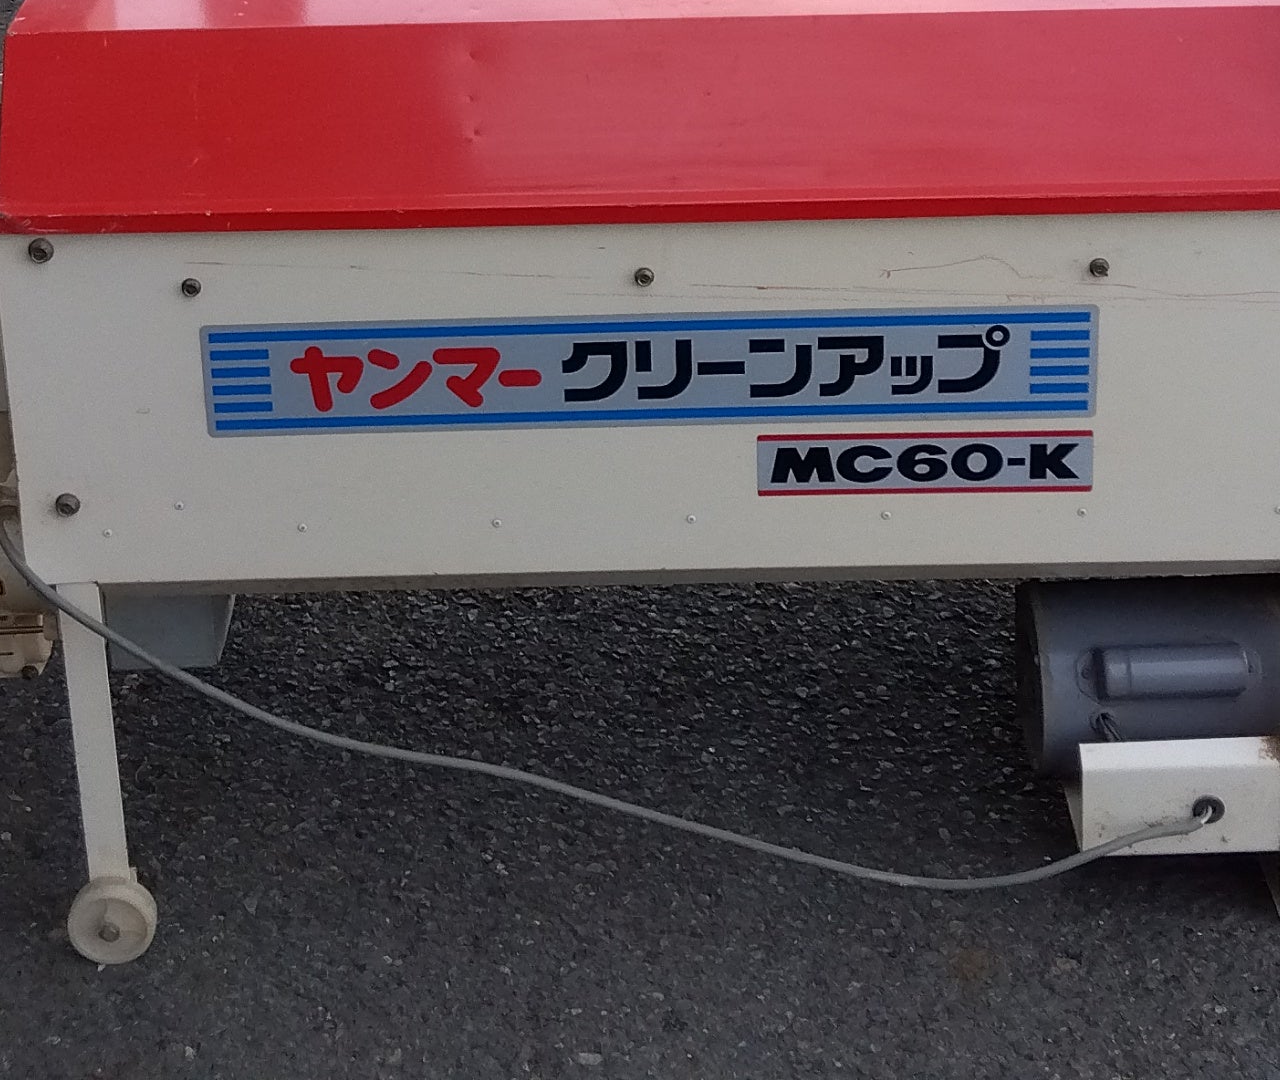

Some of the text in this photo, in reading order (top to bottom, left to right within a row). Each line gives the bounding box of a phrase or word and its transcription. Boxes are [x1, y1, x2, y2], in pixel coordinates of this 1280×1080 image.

[289, 324, 1011, 413] ヤンマー クリーンアップ
[770, 442, 1081, 484] MC60-K
